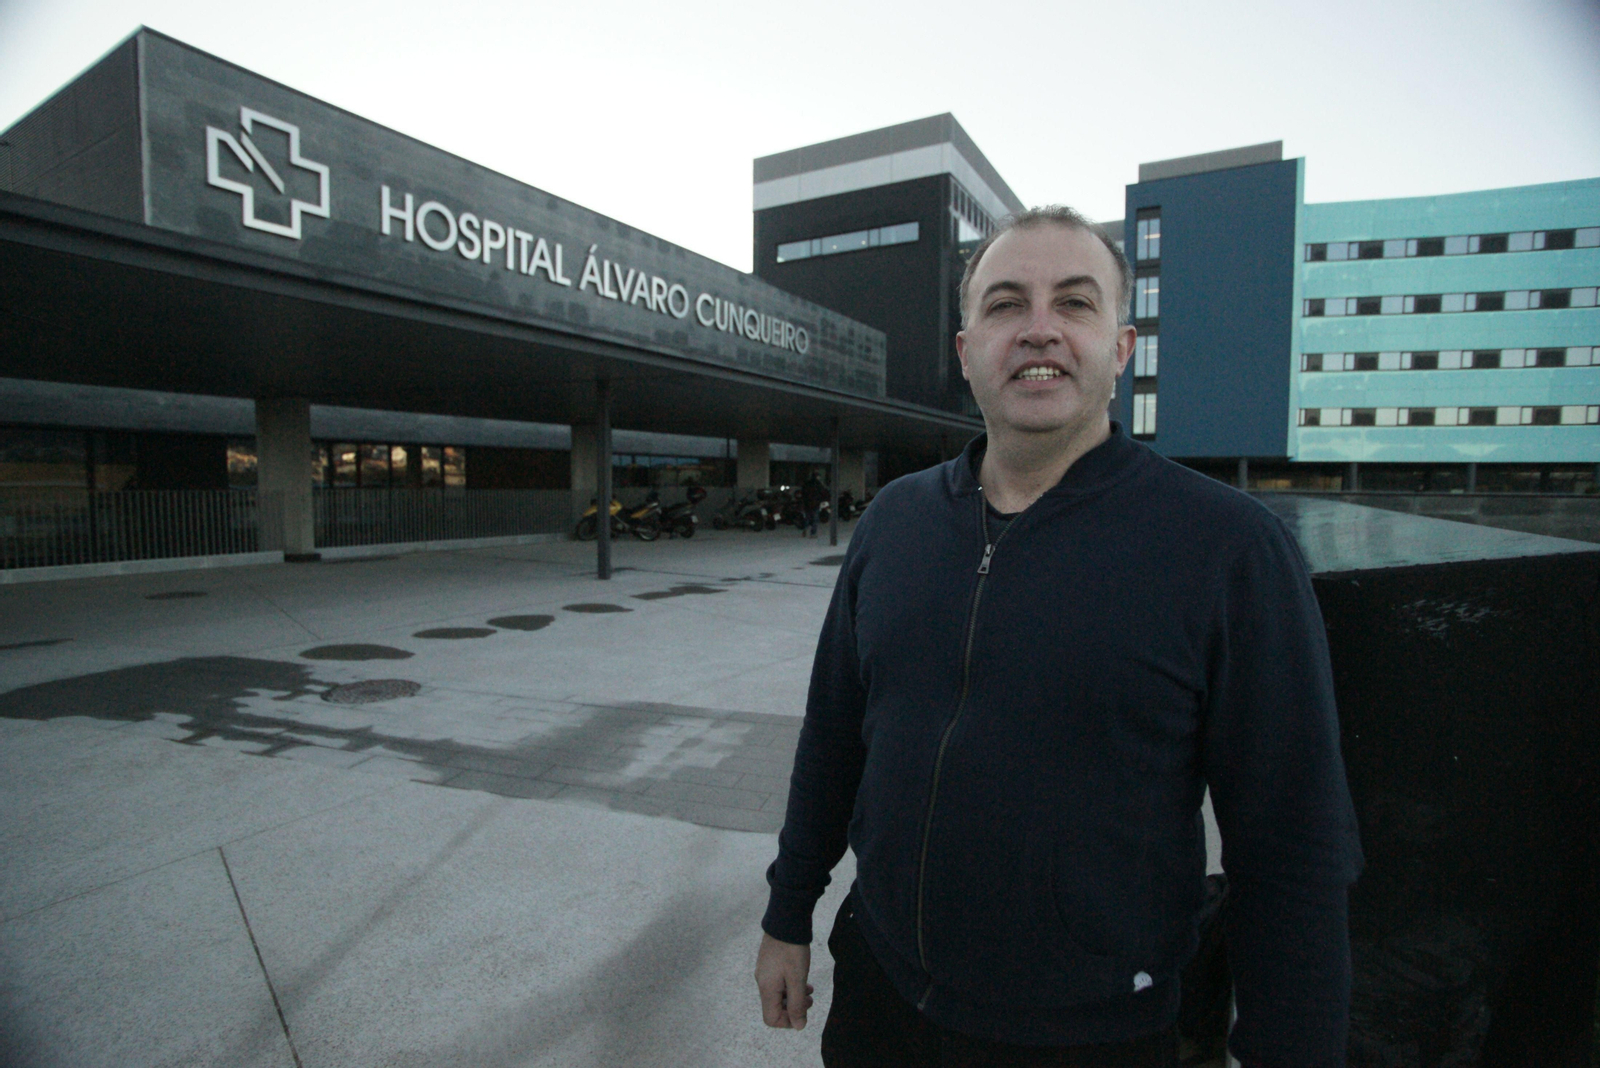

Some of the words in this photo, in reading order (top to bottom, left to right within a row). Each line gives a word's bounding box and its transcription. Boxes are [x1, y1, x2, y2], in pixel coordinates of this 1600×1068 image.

[381, 185, 571, 286] HOSPITAL
[579, 243, 689, 318] ÁLVARO
[696, 293, 809, 353] CUNQUEIRO
